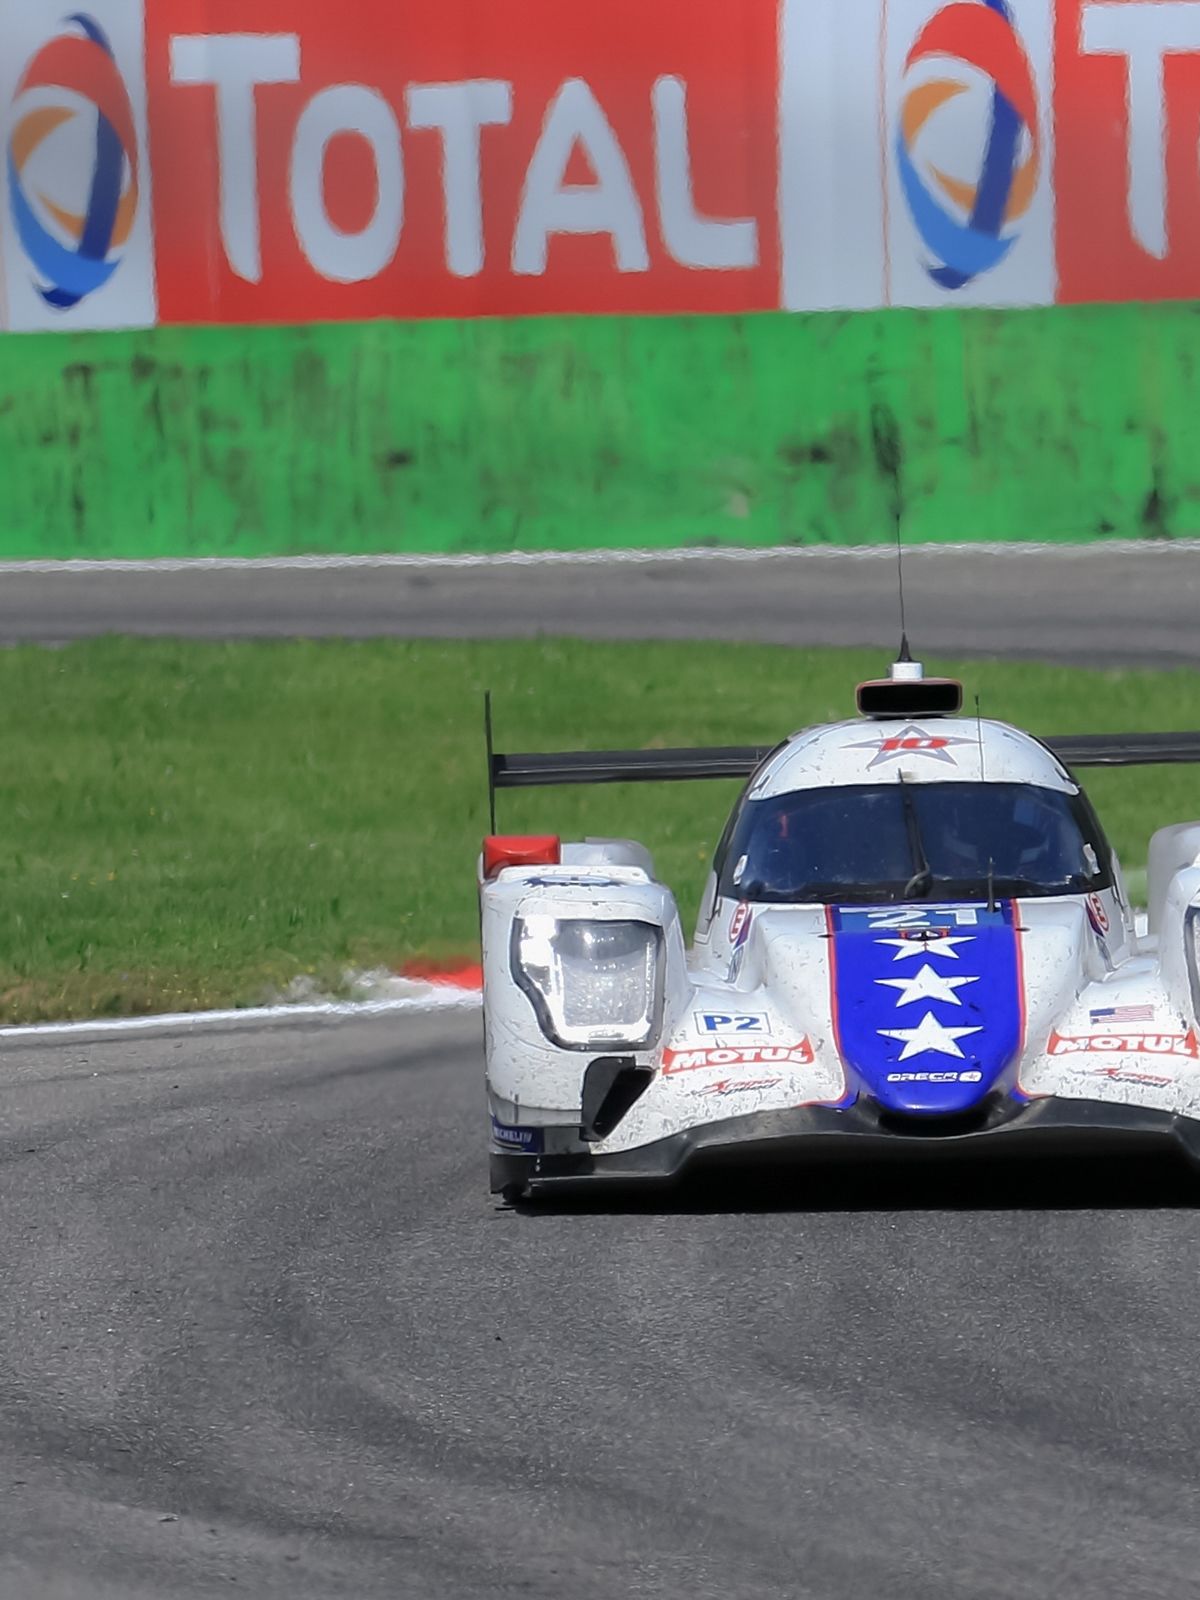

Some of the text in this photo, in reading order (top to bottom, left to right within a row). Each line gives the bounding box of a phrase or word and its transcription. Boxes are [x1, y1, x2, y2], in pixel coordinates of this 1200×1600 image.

[169, 32, 759, 284] TOTAL
[881, 736, 949, 751] 10
[867, 909, 978, 928] 21
[703, 1015, 762, 1031] P2
[1054, 1035, 1193, 1055] MOTUL
[669, 1047, 809, 1070] MOTUL
